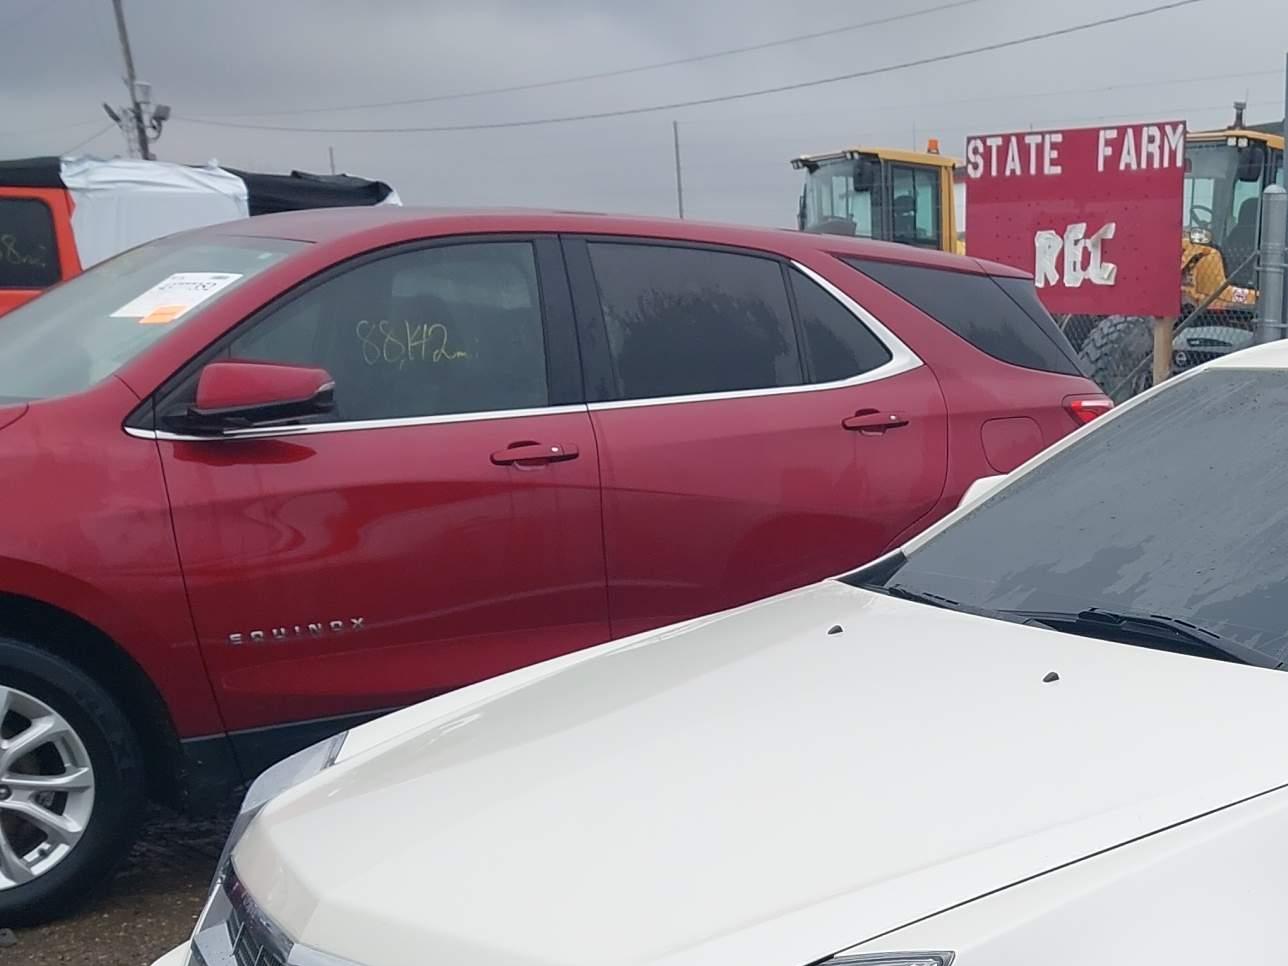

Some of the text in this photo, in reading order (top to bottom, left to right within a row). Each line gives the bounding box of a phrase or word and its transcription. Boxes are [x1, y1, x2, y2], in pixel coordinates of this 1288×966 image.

[967, 124, 1184, 178] STATE FARM
[229, 617, 364, 645] EQUINOX
